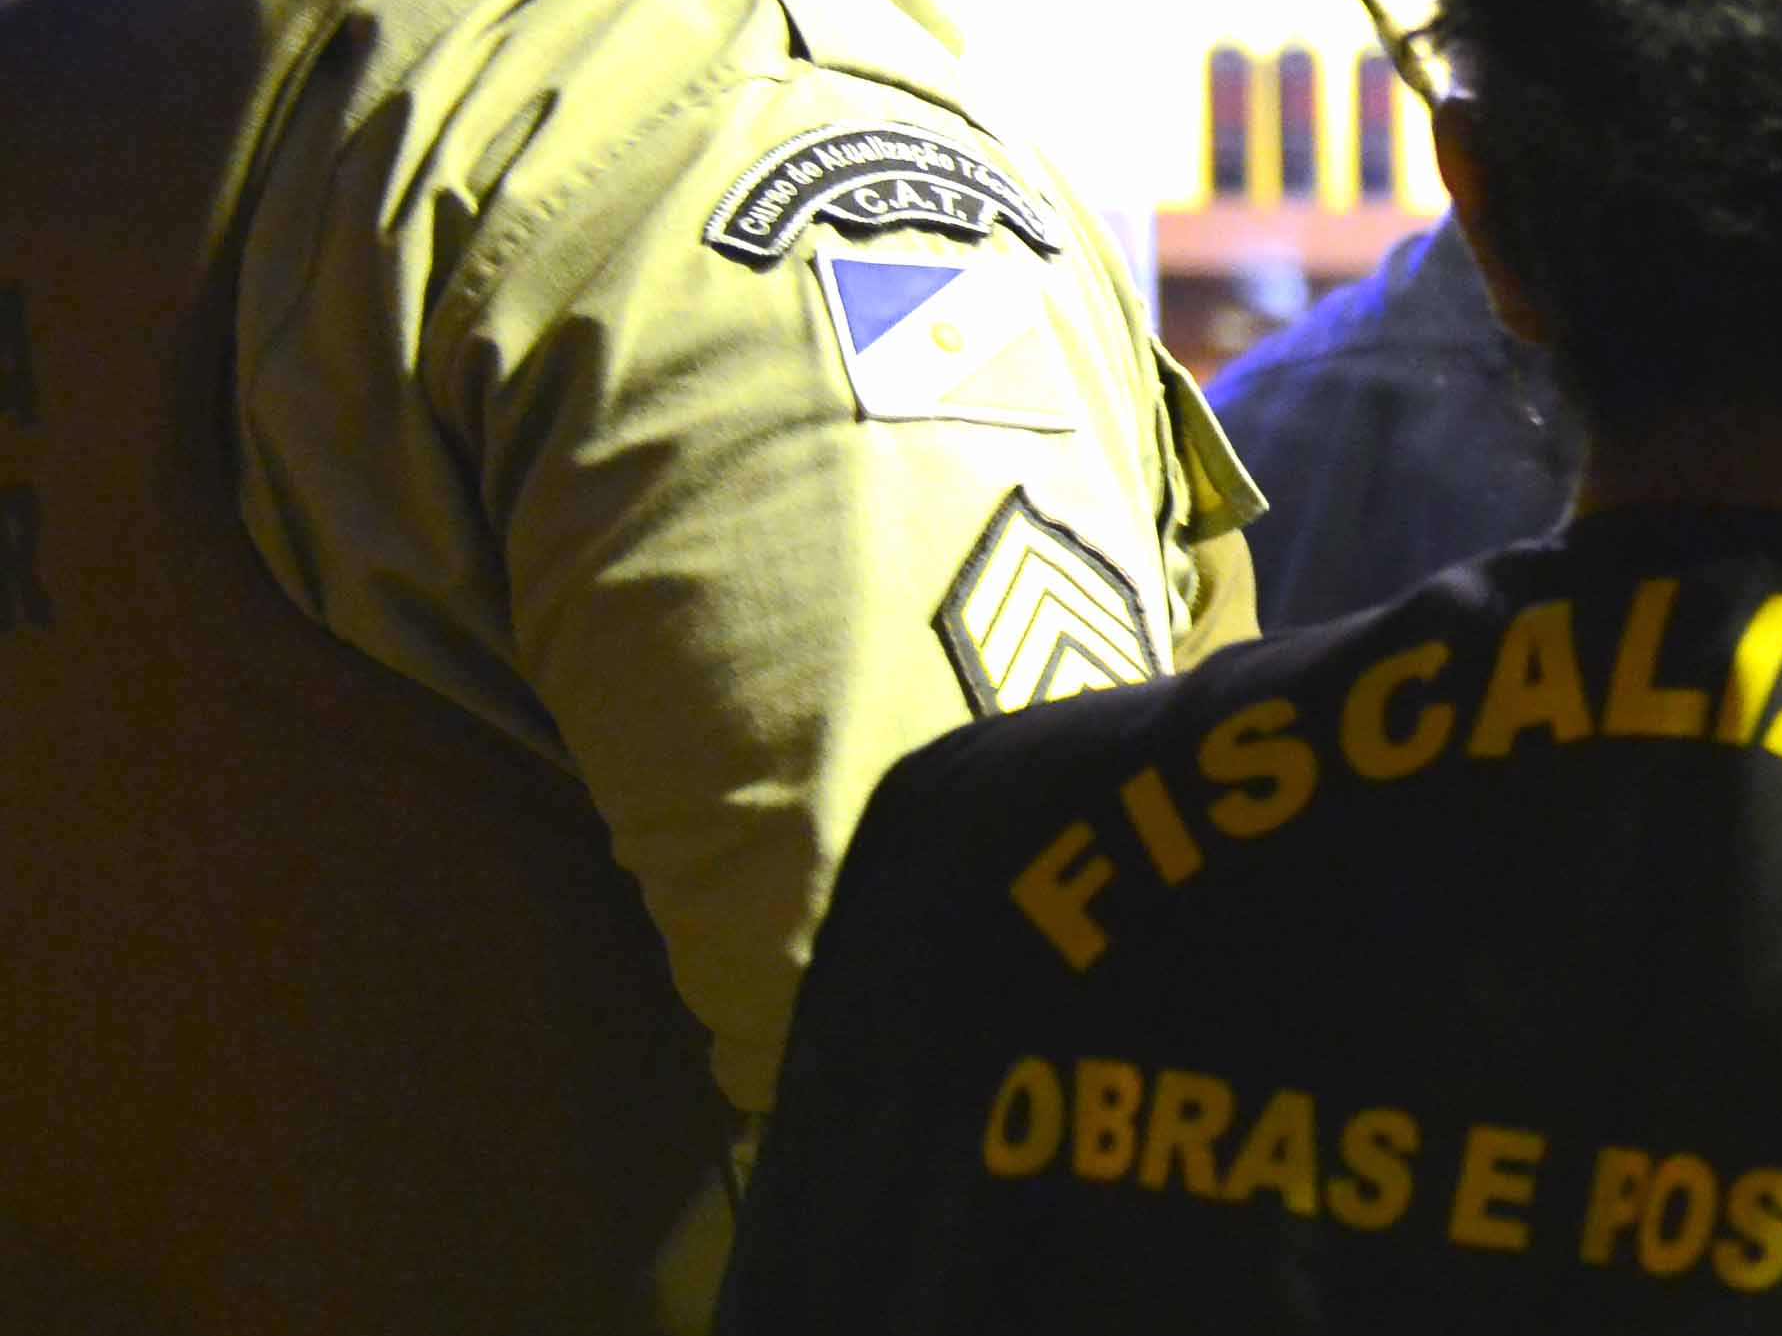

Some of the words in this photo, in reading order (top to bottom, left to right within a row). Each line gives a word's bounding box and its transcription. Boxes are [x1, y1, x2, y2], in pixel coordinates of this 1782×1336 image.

[853, 178, 968, 220] C.A.T.
[981, 1057, 1420, 1232] OBRAS
[1449, 1125, 1549, 1251] E
